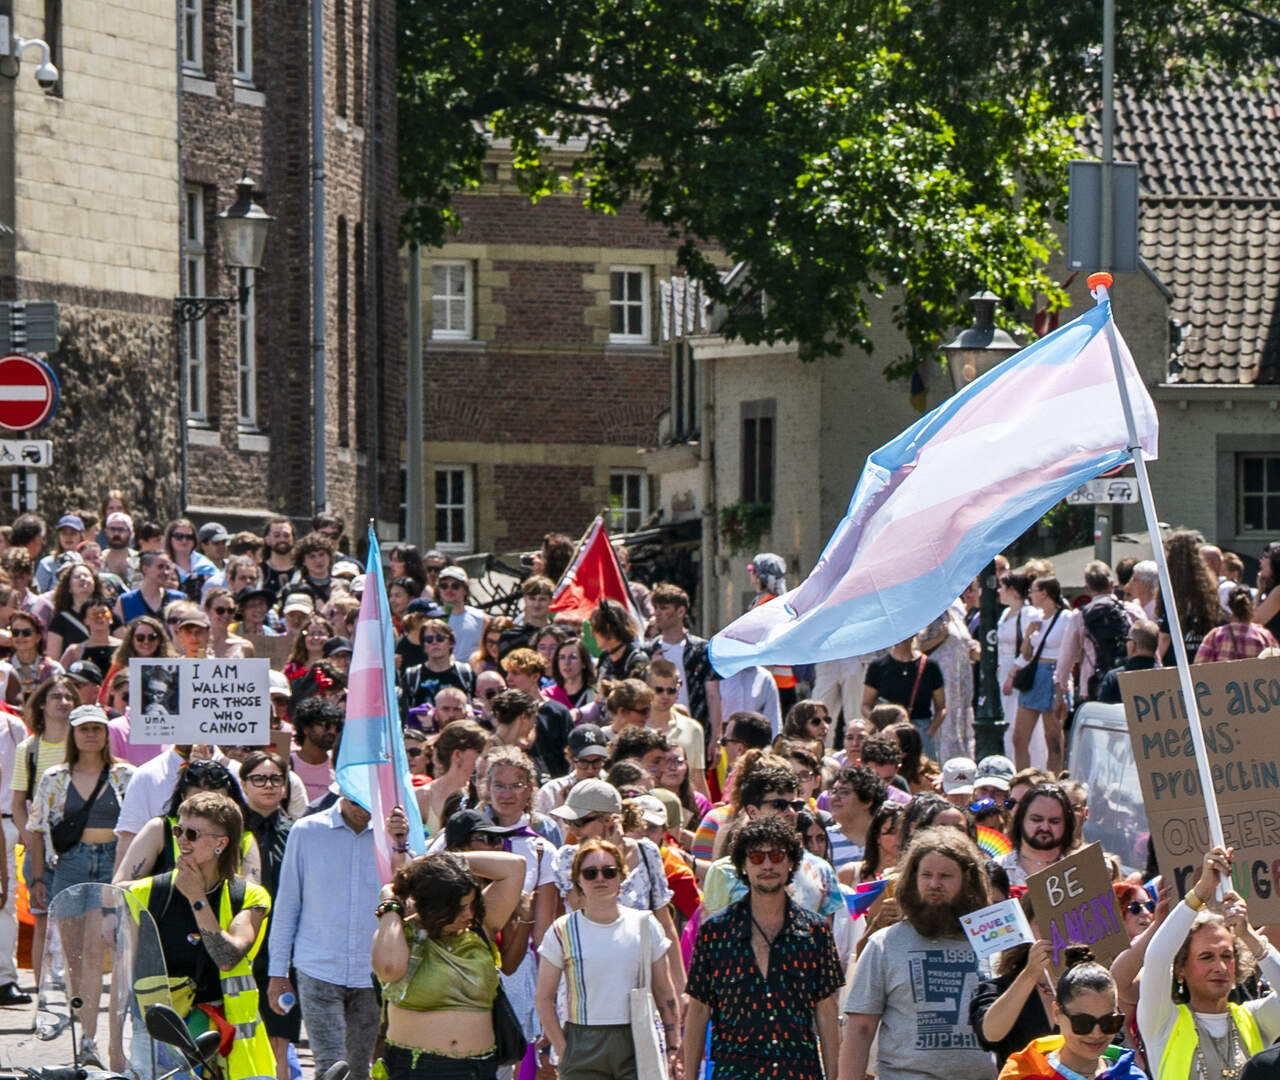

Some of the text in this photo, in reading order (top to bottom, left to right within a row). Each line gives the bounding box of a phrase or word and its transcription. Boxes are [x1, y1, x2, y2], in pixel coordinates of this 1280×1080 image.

[192, 664, 238, 679] I AM
[192, 682, 256, 693] WALKING
[192, 696, 262, 709] FOR THOSE
[213, 711, 243, 720] WHO
[200, 721, 258, 733] CANNOT
[1046, 866, 1084, 906] BE
[970, 918, 1004, 936] LOVE
[1004, 913, 1016, 923] IS
[1051, 890, 1120, 967] ANGRY
[982, 925, 1015, 942] LOVE
[943, 949, 975, 963] 1998
[928, 970, 962, 978] PREMIER
